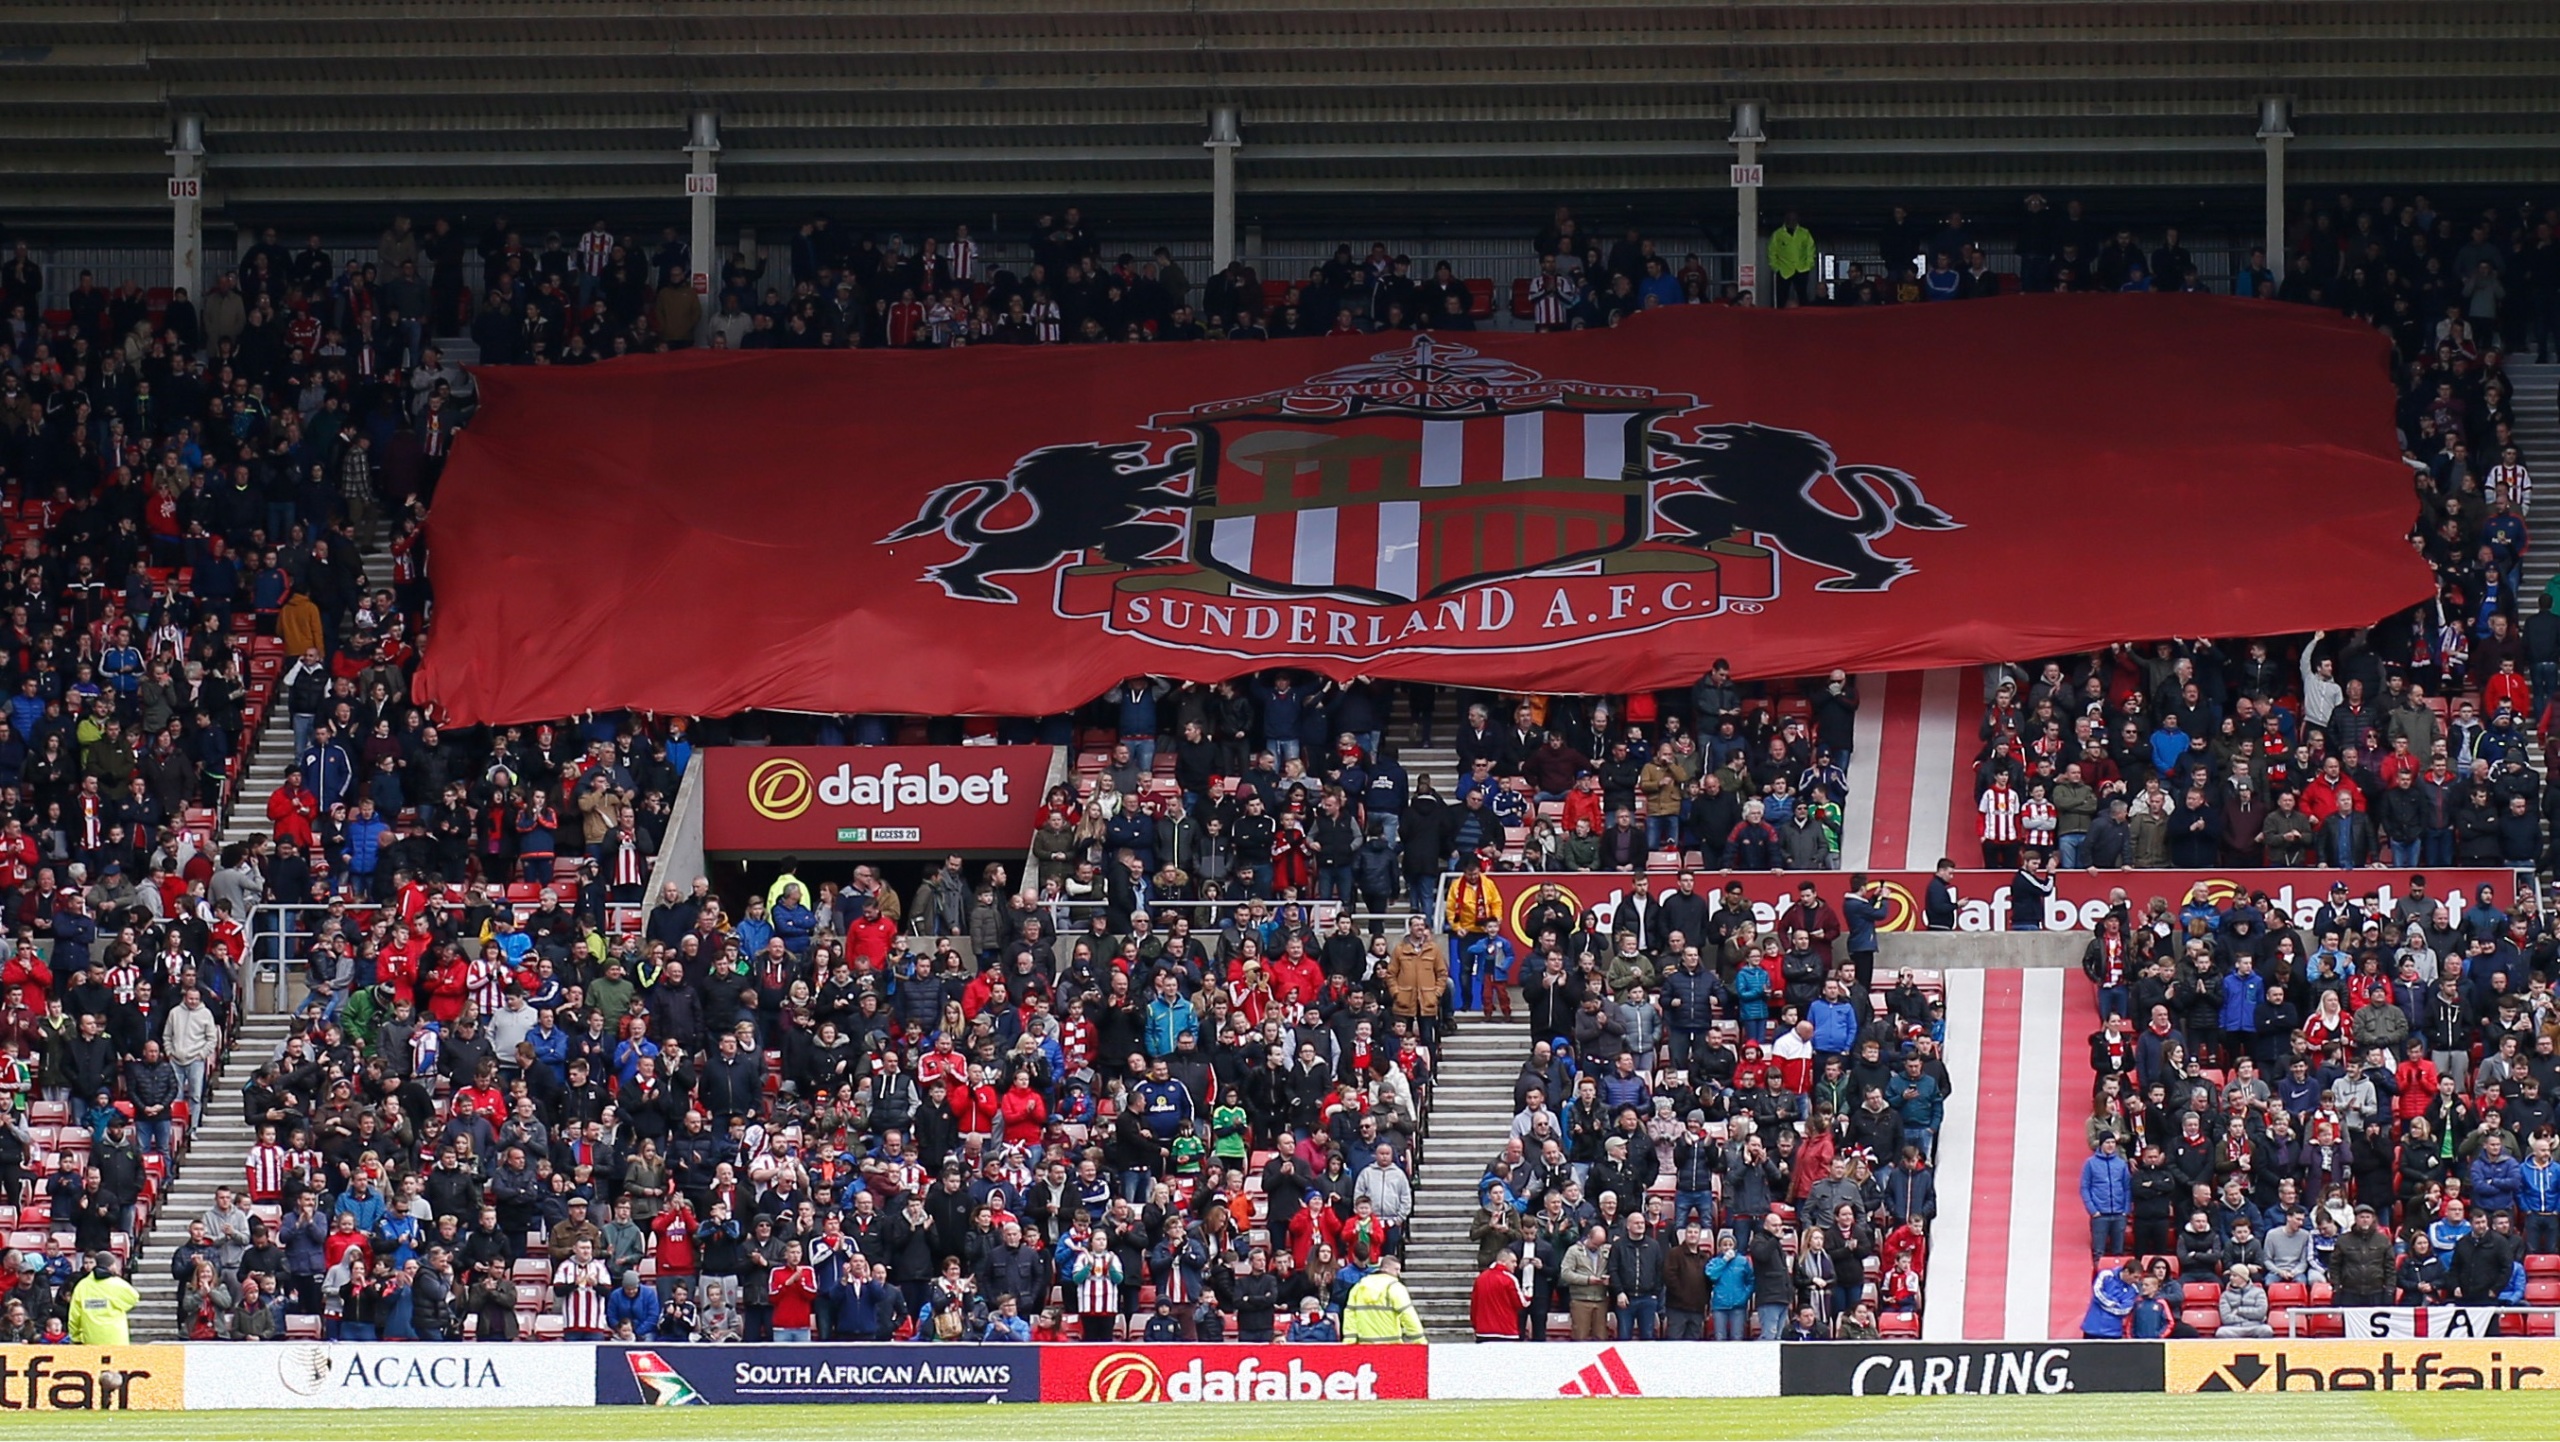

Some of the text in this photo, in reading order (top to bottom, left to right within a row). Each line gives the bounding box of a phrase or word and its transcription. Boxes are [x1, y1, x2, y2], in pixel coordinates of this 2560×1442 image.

[171, 180, 197, 197] U13
[688, 177, 714, 192] U13
[1733, 167, 1761, 184] U14
[1126, 581, 1711, 647] SUNDERLAND A.F.C.
[818, 762, 1009, 814] dafabet
[875, 830, 917, 840] ACCESS 20
[2370, 1309, 2475, 1338] S A
[341, 1352, 503, 1388] ACACIA
[735, 1361, 1011, 1386] SOUTH AFRICAN AIRWAYS
[1166, 1357, 1378, 1402] dafabet
